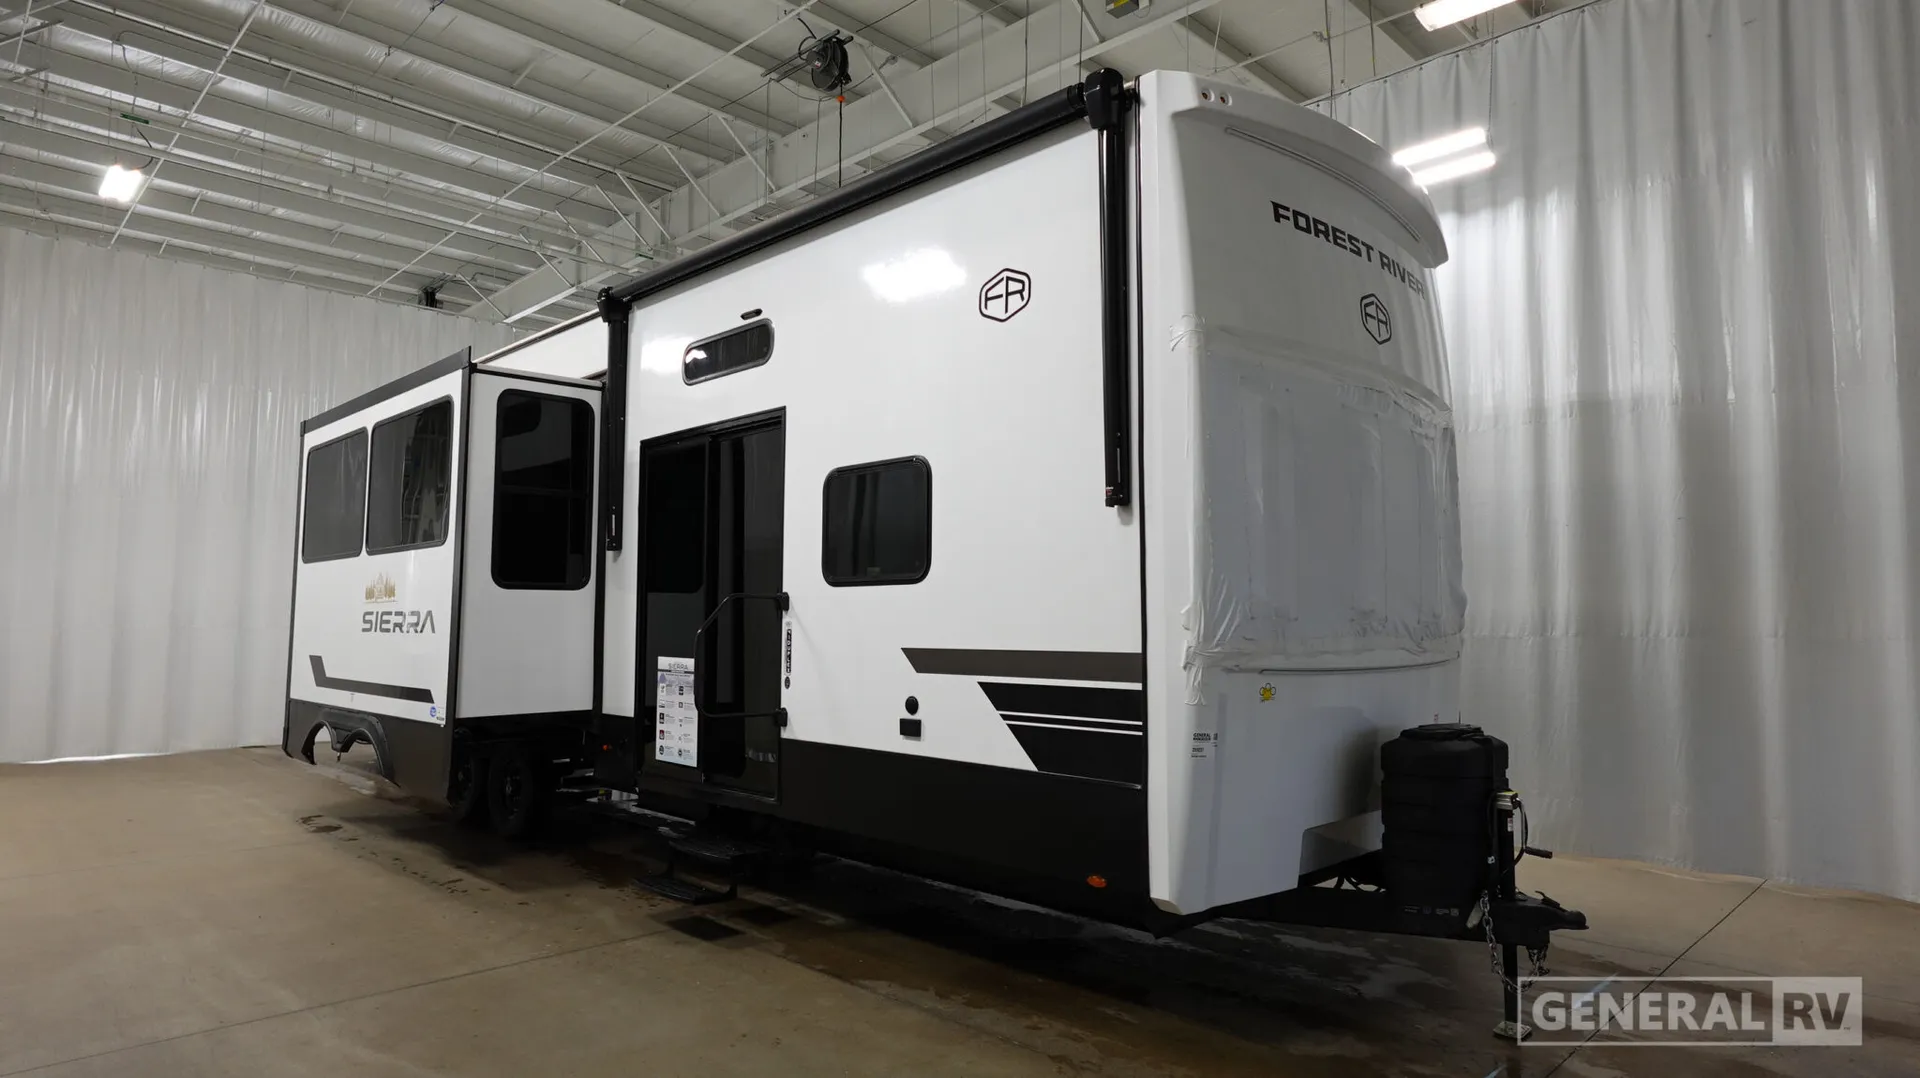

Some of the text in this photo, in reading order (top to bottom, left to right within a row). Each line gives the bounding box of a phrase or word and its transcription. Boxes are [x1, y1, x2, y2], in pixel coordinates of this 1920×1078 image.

[1270, 201, 1425, 300] FOREST RIVER
[983, 274, 1026, 315] FR
[1363, 300, 1390, 338] FR
[361, 610, 436, 634] SIERRA
